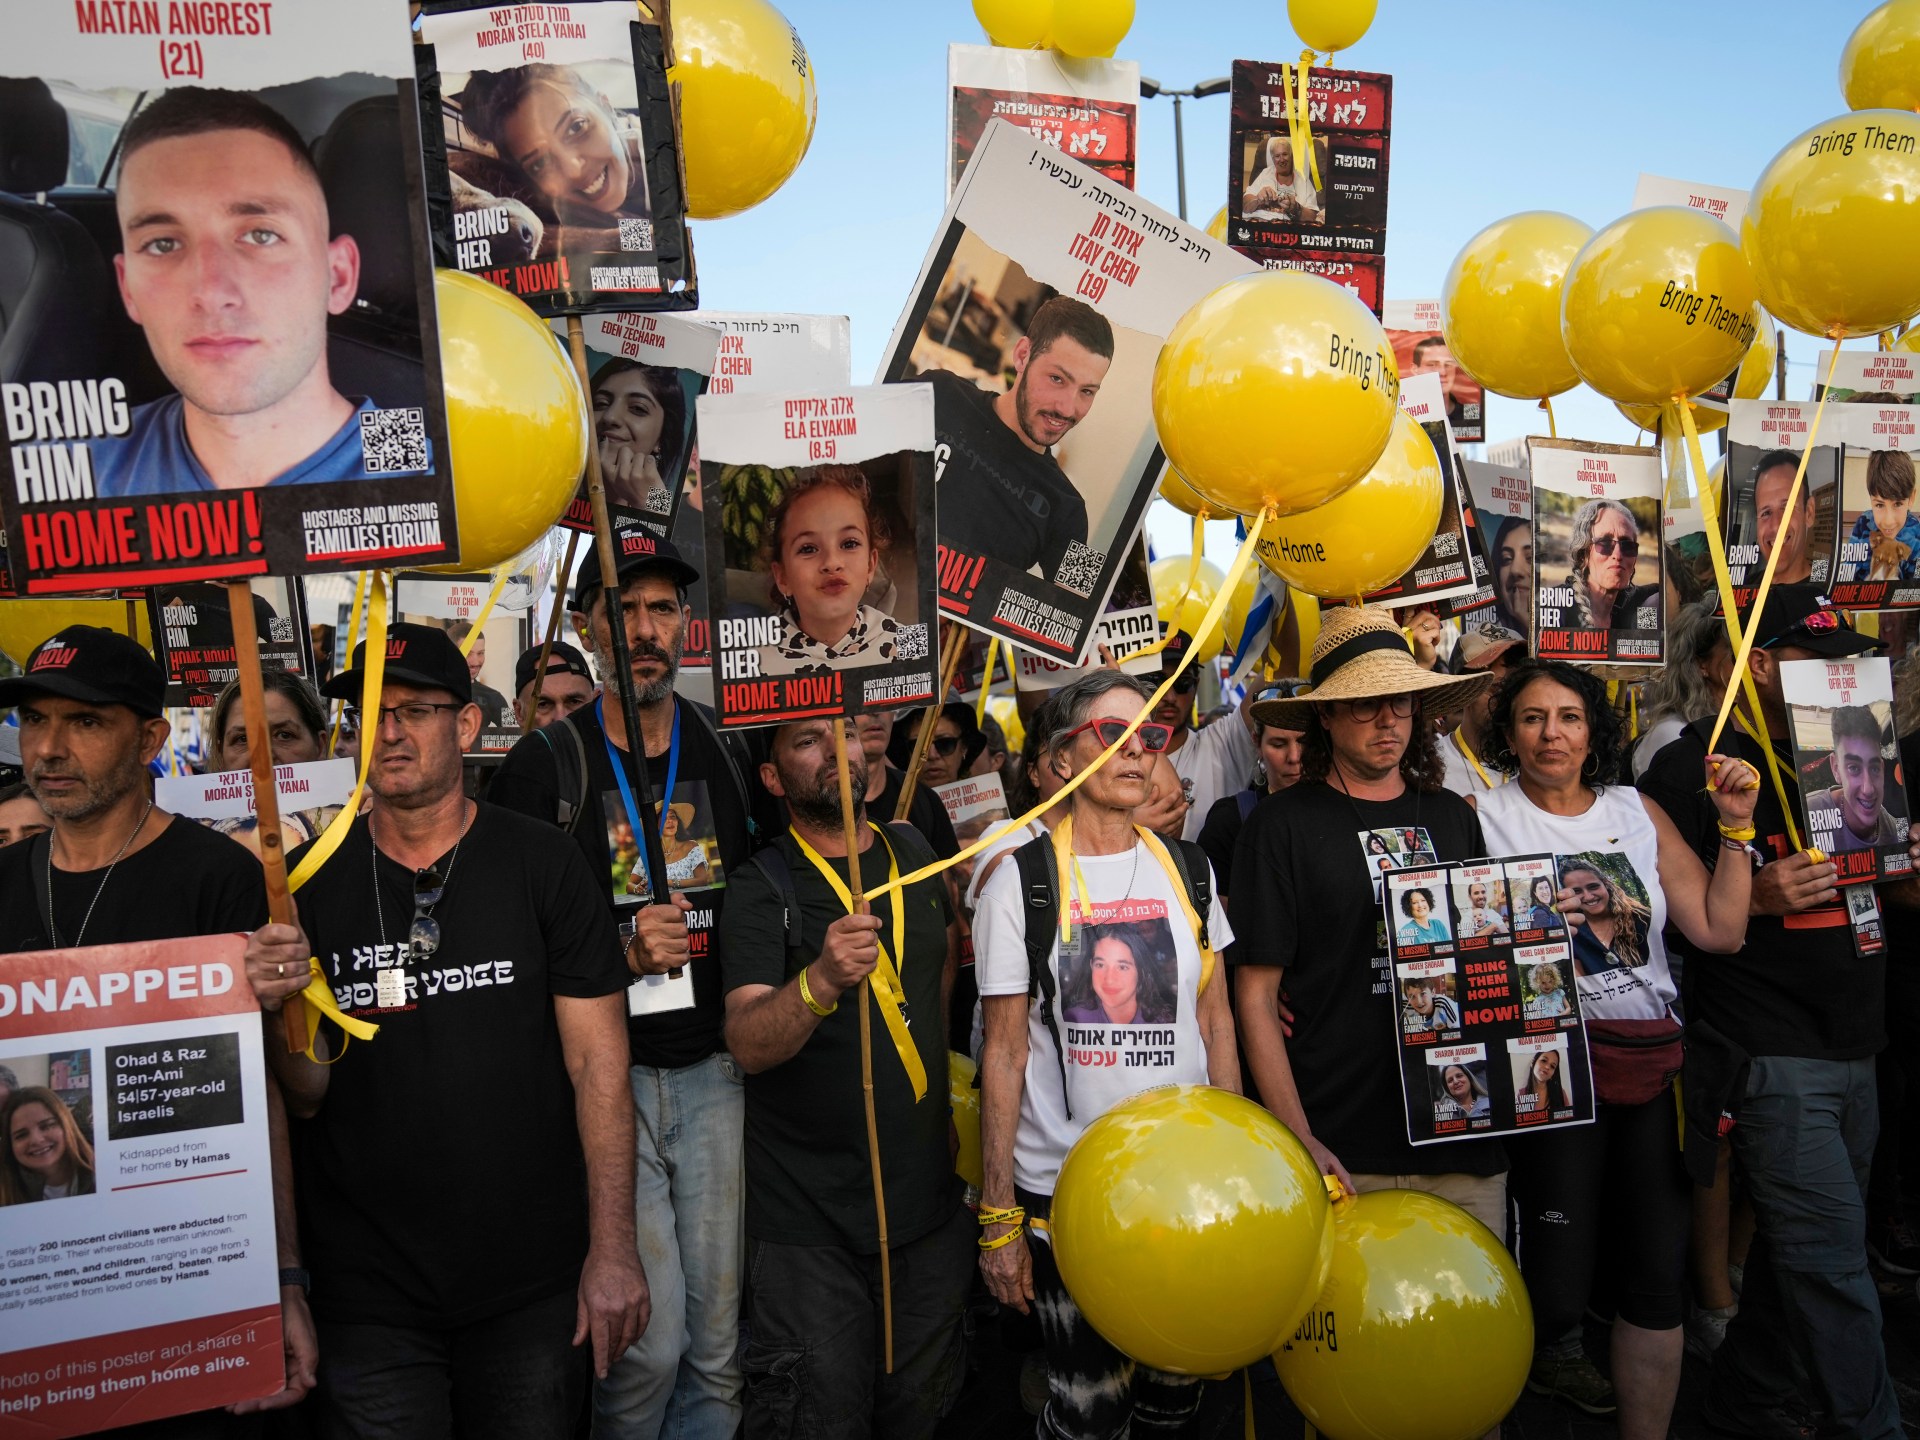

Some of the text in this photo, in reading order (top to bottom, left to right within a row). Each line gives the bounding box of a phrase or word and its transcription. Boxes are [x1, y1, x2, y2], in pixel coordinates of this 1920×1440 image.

[75, 0, 272, 35] MATAN ANGREST
[490, 6, 570, 27] מורן סטלה ינאי
[477, 23, 586, 48] MORAN STELA YANAI
[159, 40, 204, 78] (21)
[523, 41, 545, 60] (40)
[1808, 126, 1915, 156] Bring Them
[454, 206, 509, 241] BRING
[456, 240, 492, 270] HER
[1068, 232, 1140, 288] ITAY CHEN
[515, 256, 571, 295] NOW!
[591, 266, 658, 276] HOSTAGES AND MISSING
[592, 275, 660, 289] FAMILIES FORUM
[1076, 270, 1108, 304] (19)
[1660, 280, 1739, 332] Bring Them
[602, 321, 665, 349] EDEN ZECHARYA
[621, 341, 639, 358] (28)
[1330, 333, 1372, 390] Bring
[1863, 368, 1914, 379] INBAR HAIMAN
[1880, 379, 1894, 390] (27)
[1, 377, 130, 442] BRING
[784, 418, 856, 439] ELA ELYAKIM
[1761, 421, 1807, 433] OHAD YAHALOMI
[1873, 423, 1915, 435] EITAN YAHALOMI
[809, 440, 836, 460] (8.5)
[1778, 433, 1790, 446] (49)
[1888, 436, 1899, 448] (12)
[10, 442, 95, 503] HIM
[1577, 470, 1616, 484] GOREN MAYA
[1590, 483, 1604, 496] (56)
[302, 502, 439, 529] HOSTAGES AND MISSING
[22, 490, 264, 571] HOME NOW!
[304, 520, 442, 556] FAMILIES FORUM
[621, 537, 656, 552] NOW
[1280, 538, 1326, 562] Home
[1728, 544, 1759, 565] BRING
[1841, 543, 1868, 562] BRING
[1836, 564, 1857, 582] HIM
[447, 597, 478, 606] ITAY CHEN
[1539, 587, 1574, 608] BRING
[1832, 585, 1858, 602] HOME
[1860, 582, 1888, 602] NOW!
[163, 605, 197, 626] BRING
[457, 607, 469, 616] (19)
[1002, 586, 1083, 631] HOSTAGES AND MISSING
[1539, 608, 1560, 628] HER
[719, 616, 781, 649] BRING
[995, 600, 1078, 649] FAMILIES FORUM
[166, 627, 190, 648] HIM
[1539, 629, 1608, 652] HOME NOW!
[33, 648, 78, 668] NOW
[721, 650, 760, 680] HER
[864, 672, 931, 690] HOSTAGES AND MISSING
[723, 672, 842, 713] HOME NOW!
[864, 684, 931, 702] FAMILIES FORUM
[204, 779, 309, 802] MORAN YANAI
[1809, 807, 1843, 831] BRING
[1812, 831, 1835, 852] HIM
[1849, 848, 1876, 876] NOW!
[1465, 960, 1507, 974] BRING
[421, 960, 515, 996] VOICE
[1467, 973, 1508, 988] THEM
[1467, 986, 1510, 1001] HOME
[1464, 1004, 1520, 1026] NOW!
[1068, 1029, 1175, 1046] מחזירים אותם
[116, 1048, 207, 1068] Ohad & Raz
[1125, 1050, 1175, 1067] הביתה
[116, 1068, 184, 1086] Ben-Ami
[118, 1106, 174, 1123] Israelis
[120, 1141, 207, 1161] Kidnapped from
[120, 1151, 230, 1175] her home by Hamas
[39, 1216, 224, 1252] 200 innocent civilians were abducted
[10, 1272, 51, 1286] women,
[54, 1268, 79, 1279] men,
[82, 1262, 101, 1273] and
[45, 1330, 255, 1381] of this poster and share it
[0, 1355, 250, 1414] help bring them home alive.
